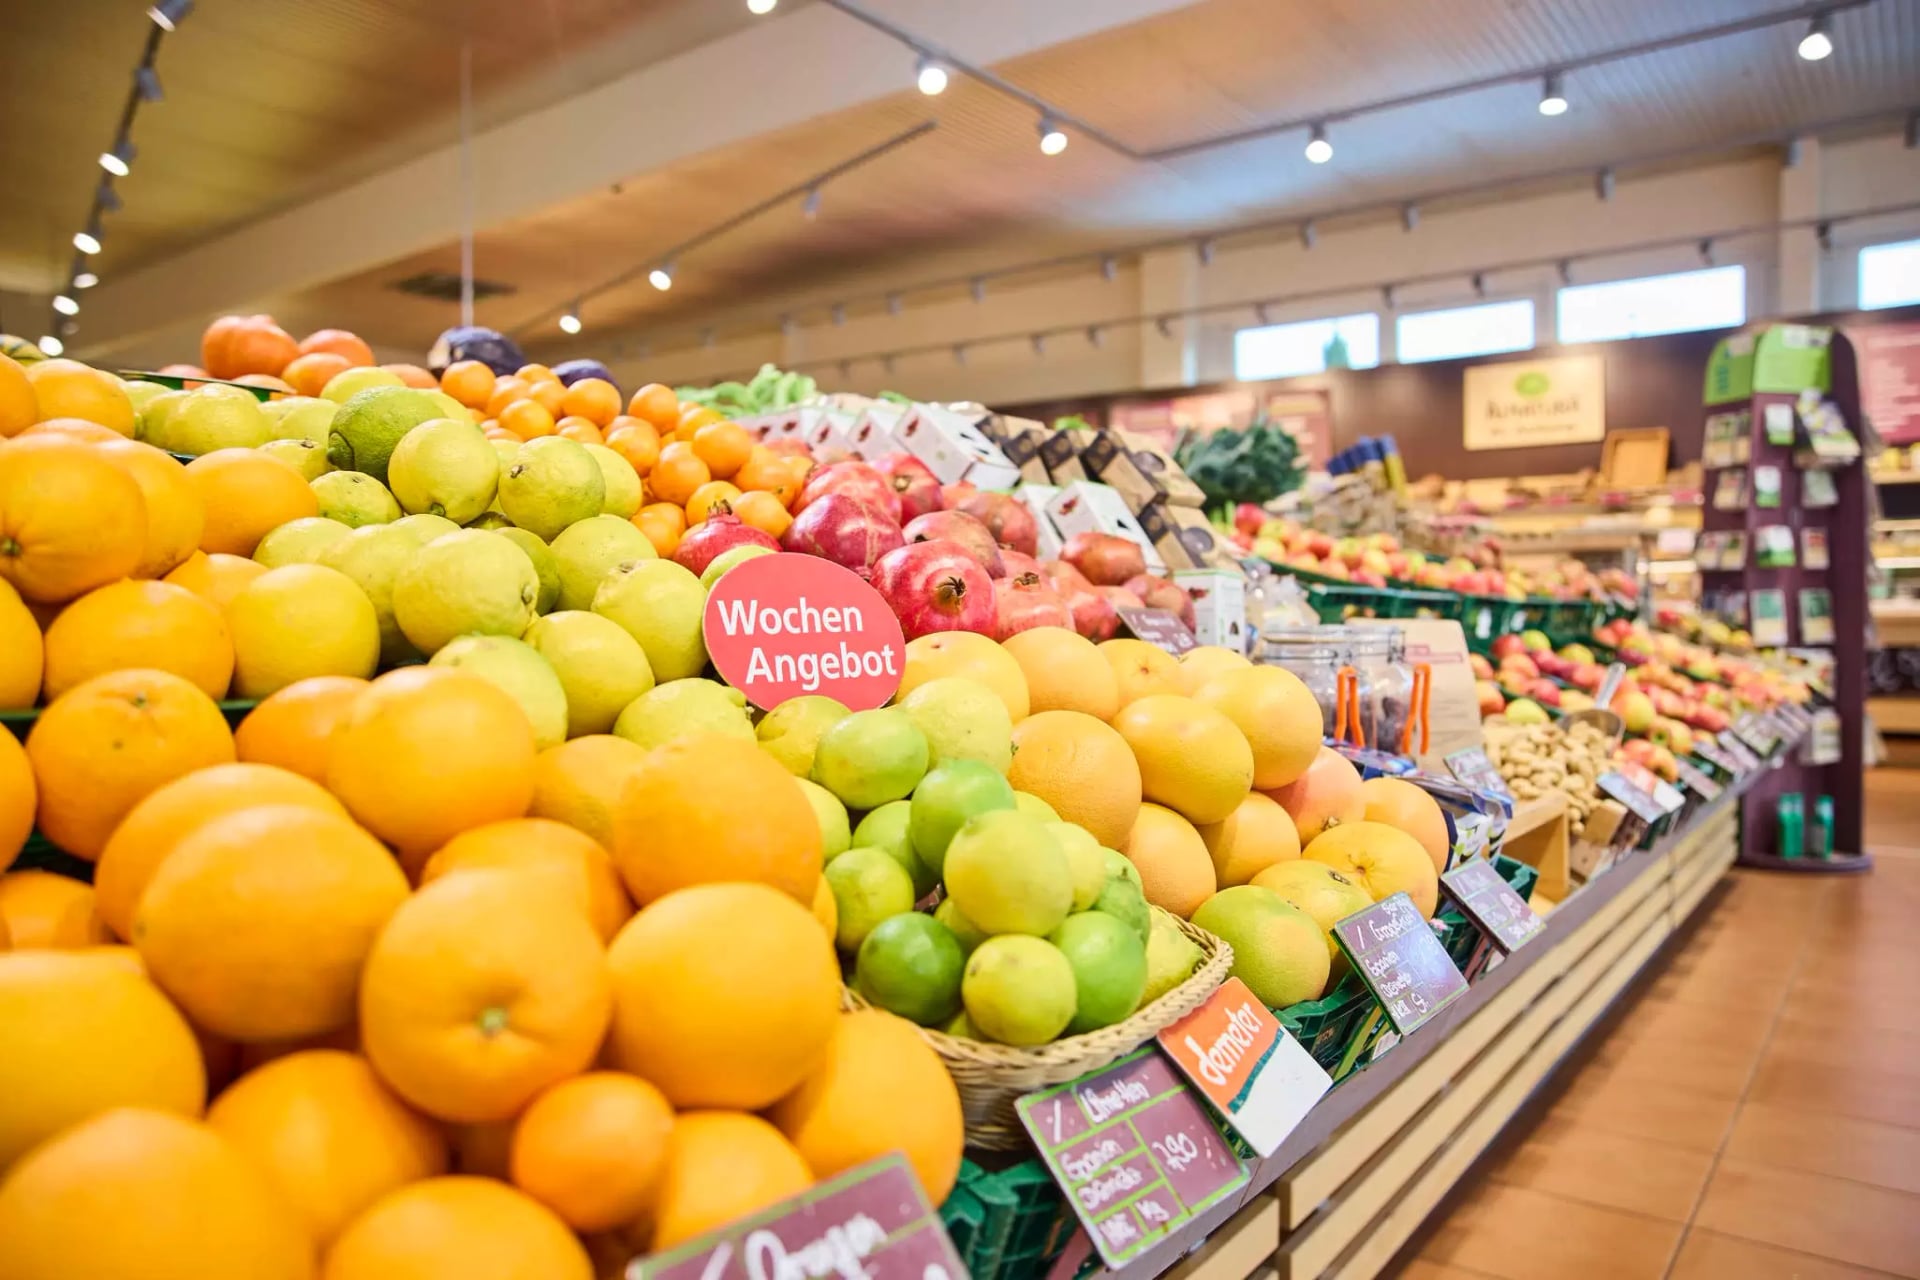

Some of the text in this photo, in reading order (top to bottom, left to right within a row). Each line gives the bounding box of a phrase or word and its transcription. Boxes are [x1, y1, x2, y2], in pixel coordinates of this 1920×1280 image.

[716, 597, 863, 636] Wochen
[745, 641, 897, 691] Angebot
[1184, 1001, 1263, 1086] demeter
